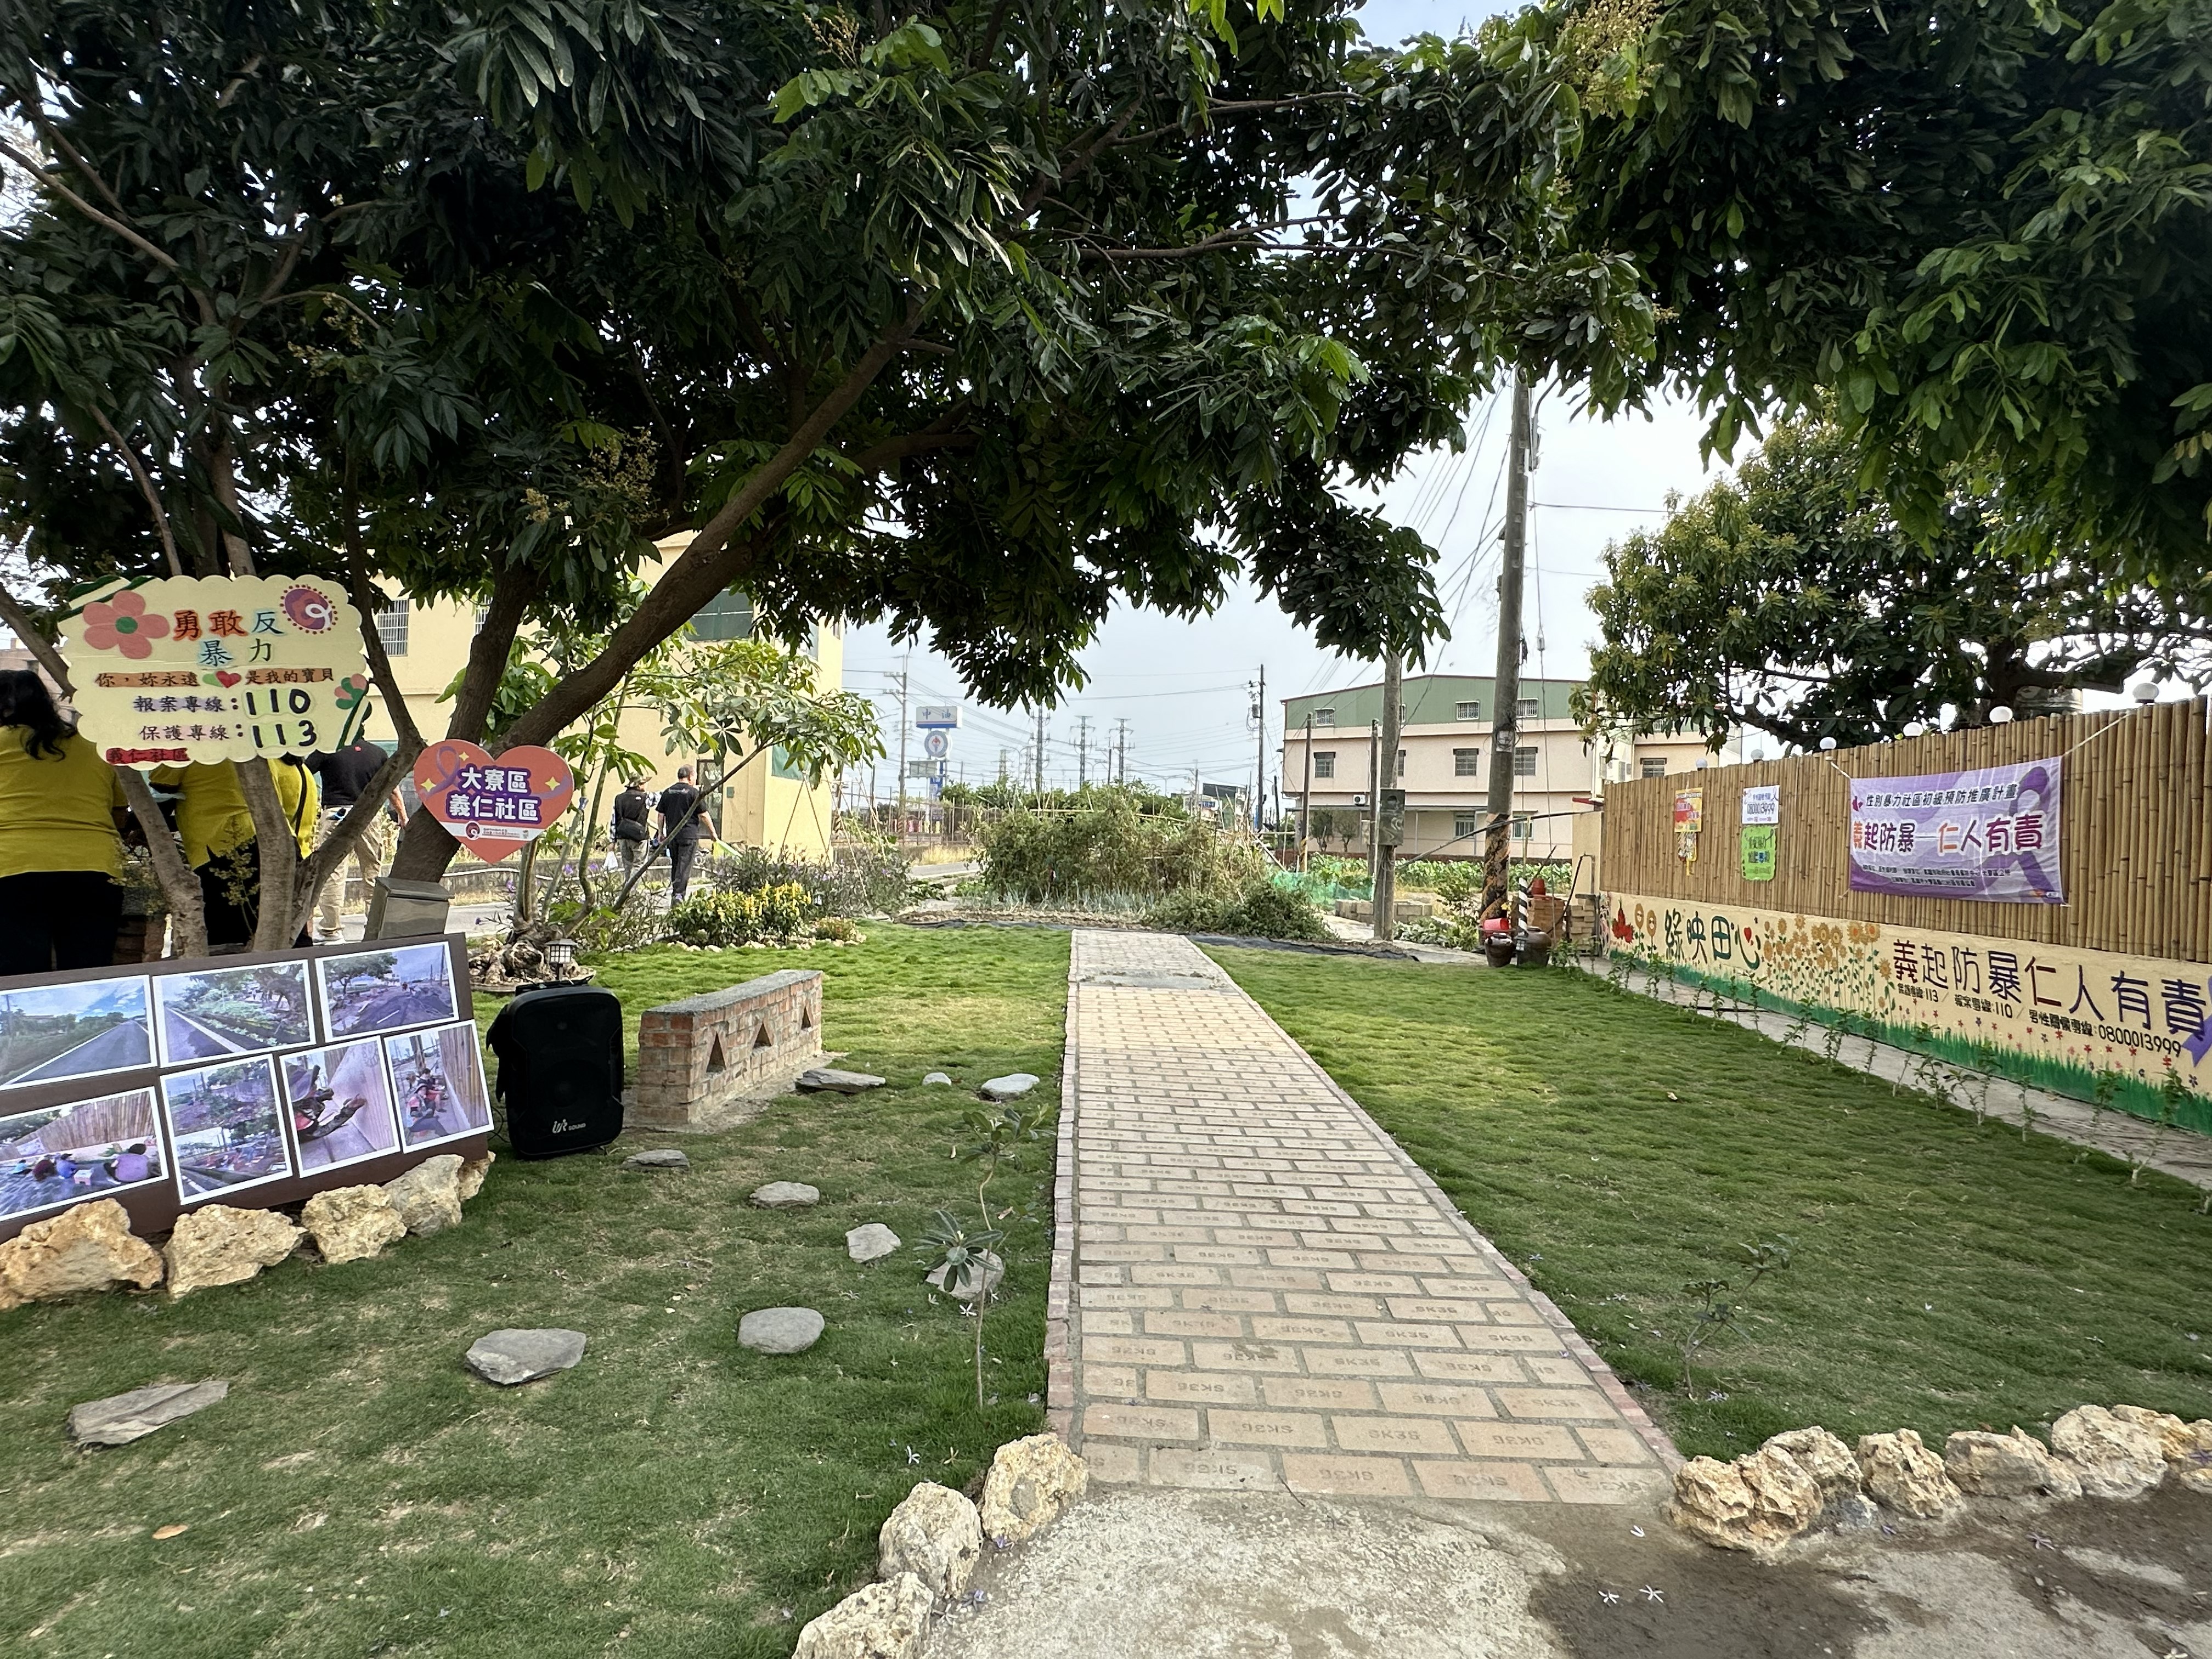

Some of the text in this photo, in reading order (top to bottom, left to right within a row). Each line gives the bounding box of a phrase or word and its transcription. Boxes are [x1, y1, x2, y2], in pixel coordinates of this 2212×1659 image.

[174, 610, 283, 639] 勇敢反
[200, 639, 272, 667] 暴力
[245, 668, 334, 685] 是我的寶貝
[461, 767, 528, 793] 大寮區
[449, 794, 539, 821] 義仁社區
[1665, 908, 1761, 970] 綠映田心
[1893, 938, 2207, 1041] 義起防暴仁人有責
[1178, 1383, 1224, 1392] SK36
[1242, 1423, 1293, 1434] SK36
